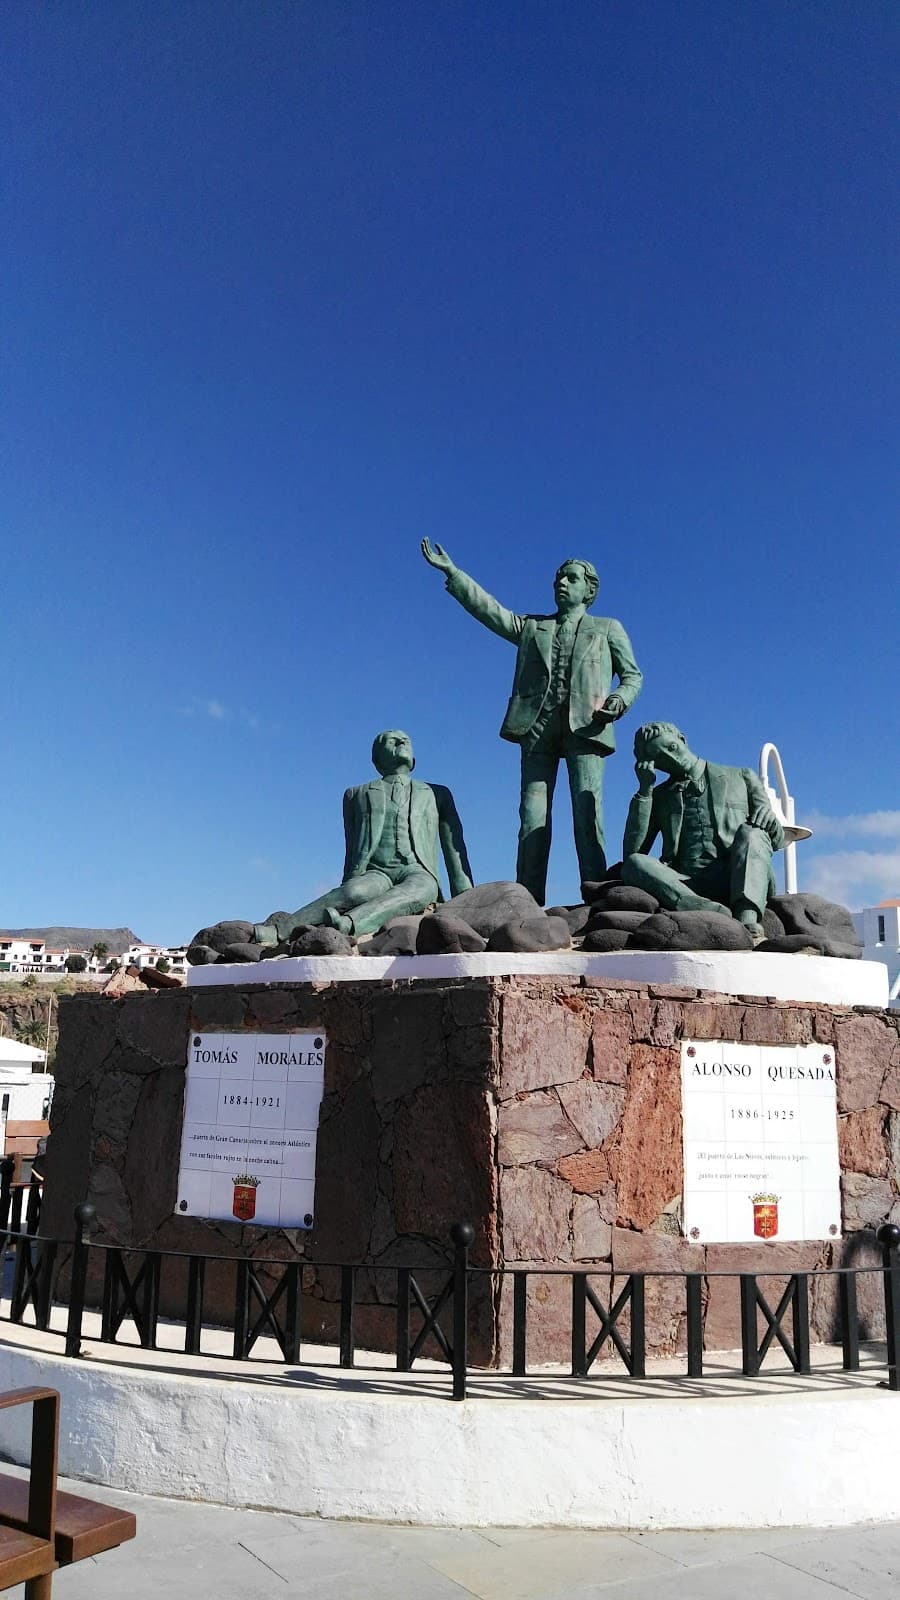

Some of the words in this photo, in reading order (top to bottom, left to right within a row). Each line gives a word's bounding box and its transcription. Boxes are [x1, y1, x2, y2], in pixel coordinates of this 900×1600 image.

[194, 1046, 238, 1064] TOMÁS
[257, 1051, 323, 1066] MORALES
[692, 1062, 752, 1078] ALONSO
[767, 1065, 834, 1082] QUESADA
[223, 1095, 281, 1107] 1884-1921
[730, 1108, 795, 1120] 1886-1925
